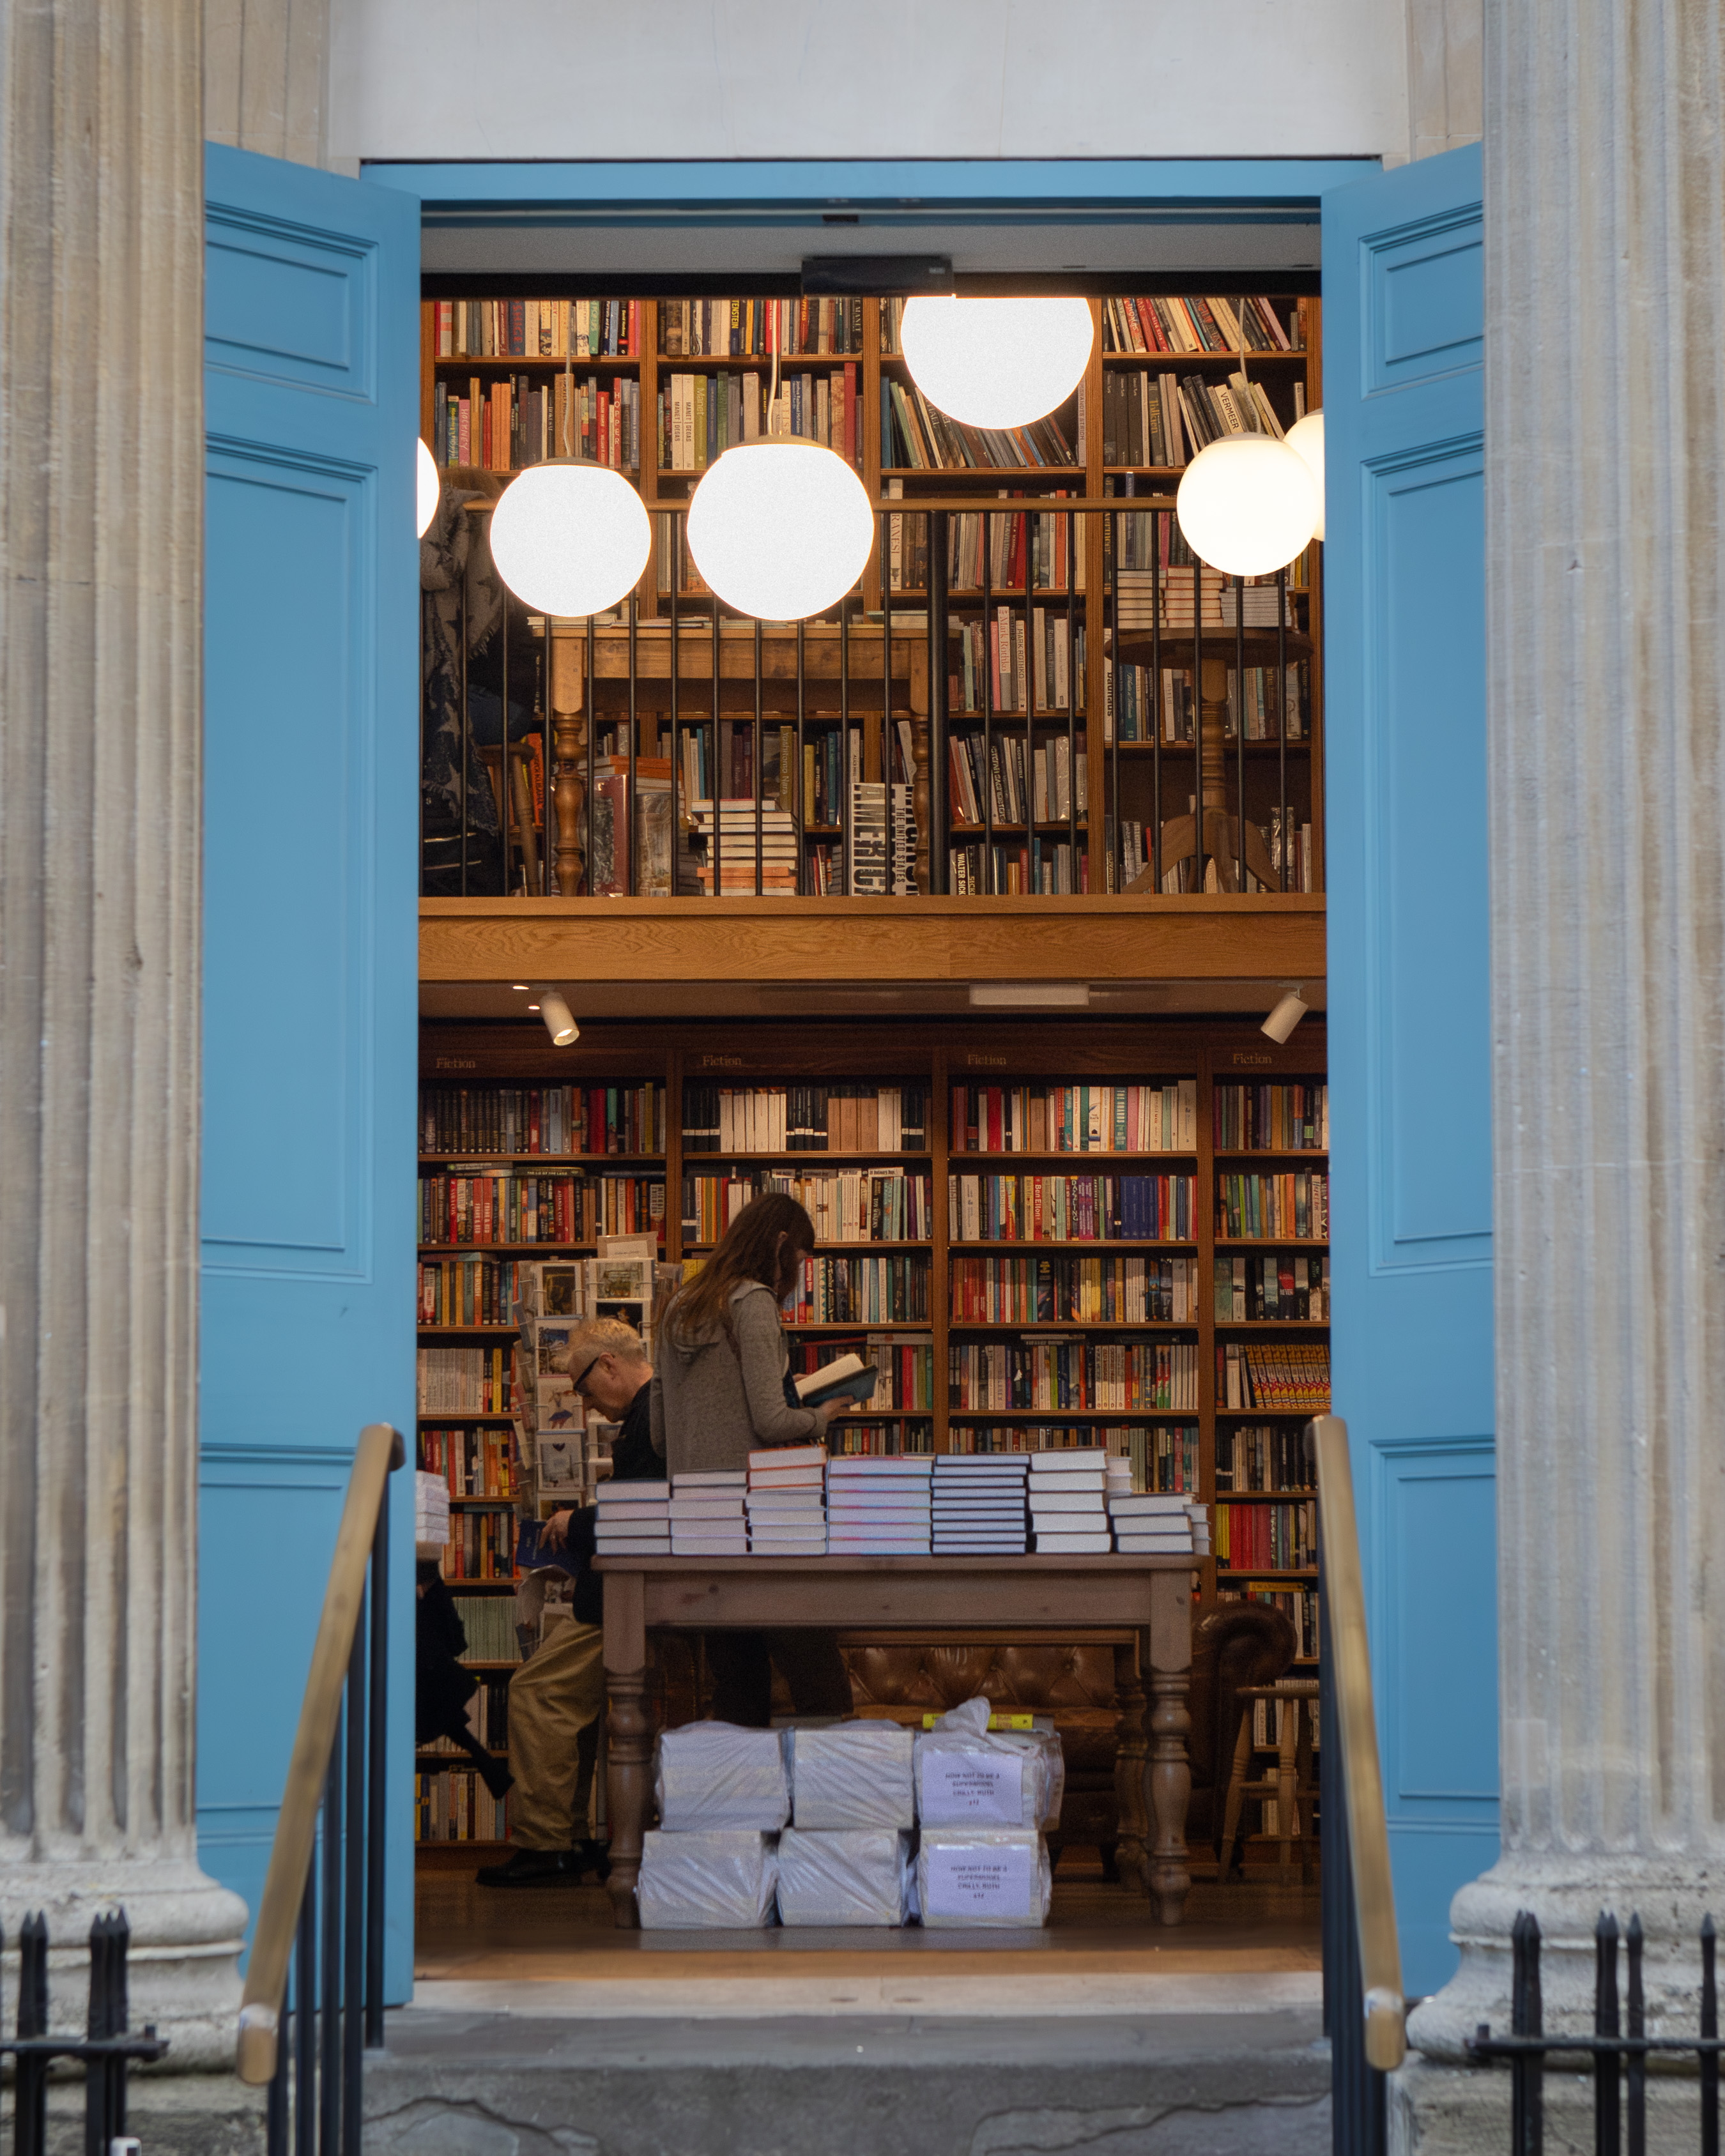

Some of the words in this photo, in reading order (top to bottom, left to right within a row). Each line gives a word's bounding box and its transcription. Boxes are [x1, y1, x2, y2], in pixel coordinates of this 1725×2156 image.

[696, 387, 705, 415] Manet
[1220, 392, 1240, 429] VERMEER
[460, 408, 469, 450] HOCKNEY
[1003, 523, 1011, 561] RAVILIOUS
[999, 616, 1008, 639] Mark
[1000, 641, 1009, 671] Rothko
[781, 732, 790, 774] Yoshitomo
[781, 776, 790, 795] Nara
[896, 807, 905, 821] THE
[854, 783, 895, 895] AMERIC
[896, 823, 905, 852] UNITED
[896, 854, 905, 883] STATES
[957, 853, 965, 878] WALTER
[435, 1058, 476, 1069] Fiction
[702, 1055, 742, 1066] Fiction
[967, 1054, 1007, 1065] Fiction
[1233, 1053, 1273, 1064] Fiction
